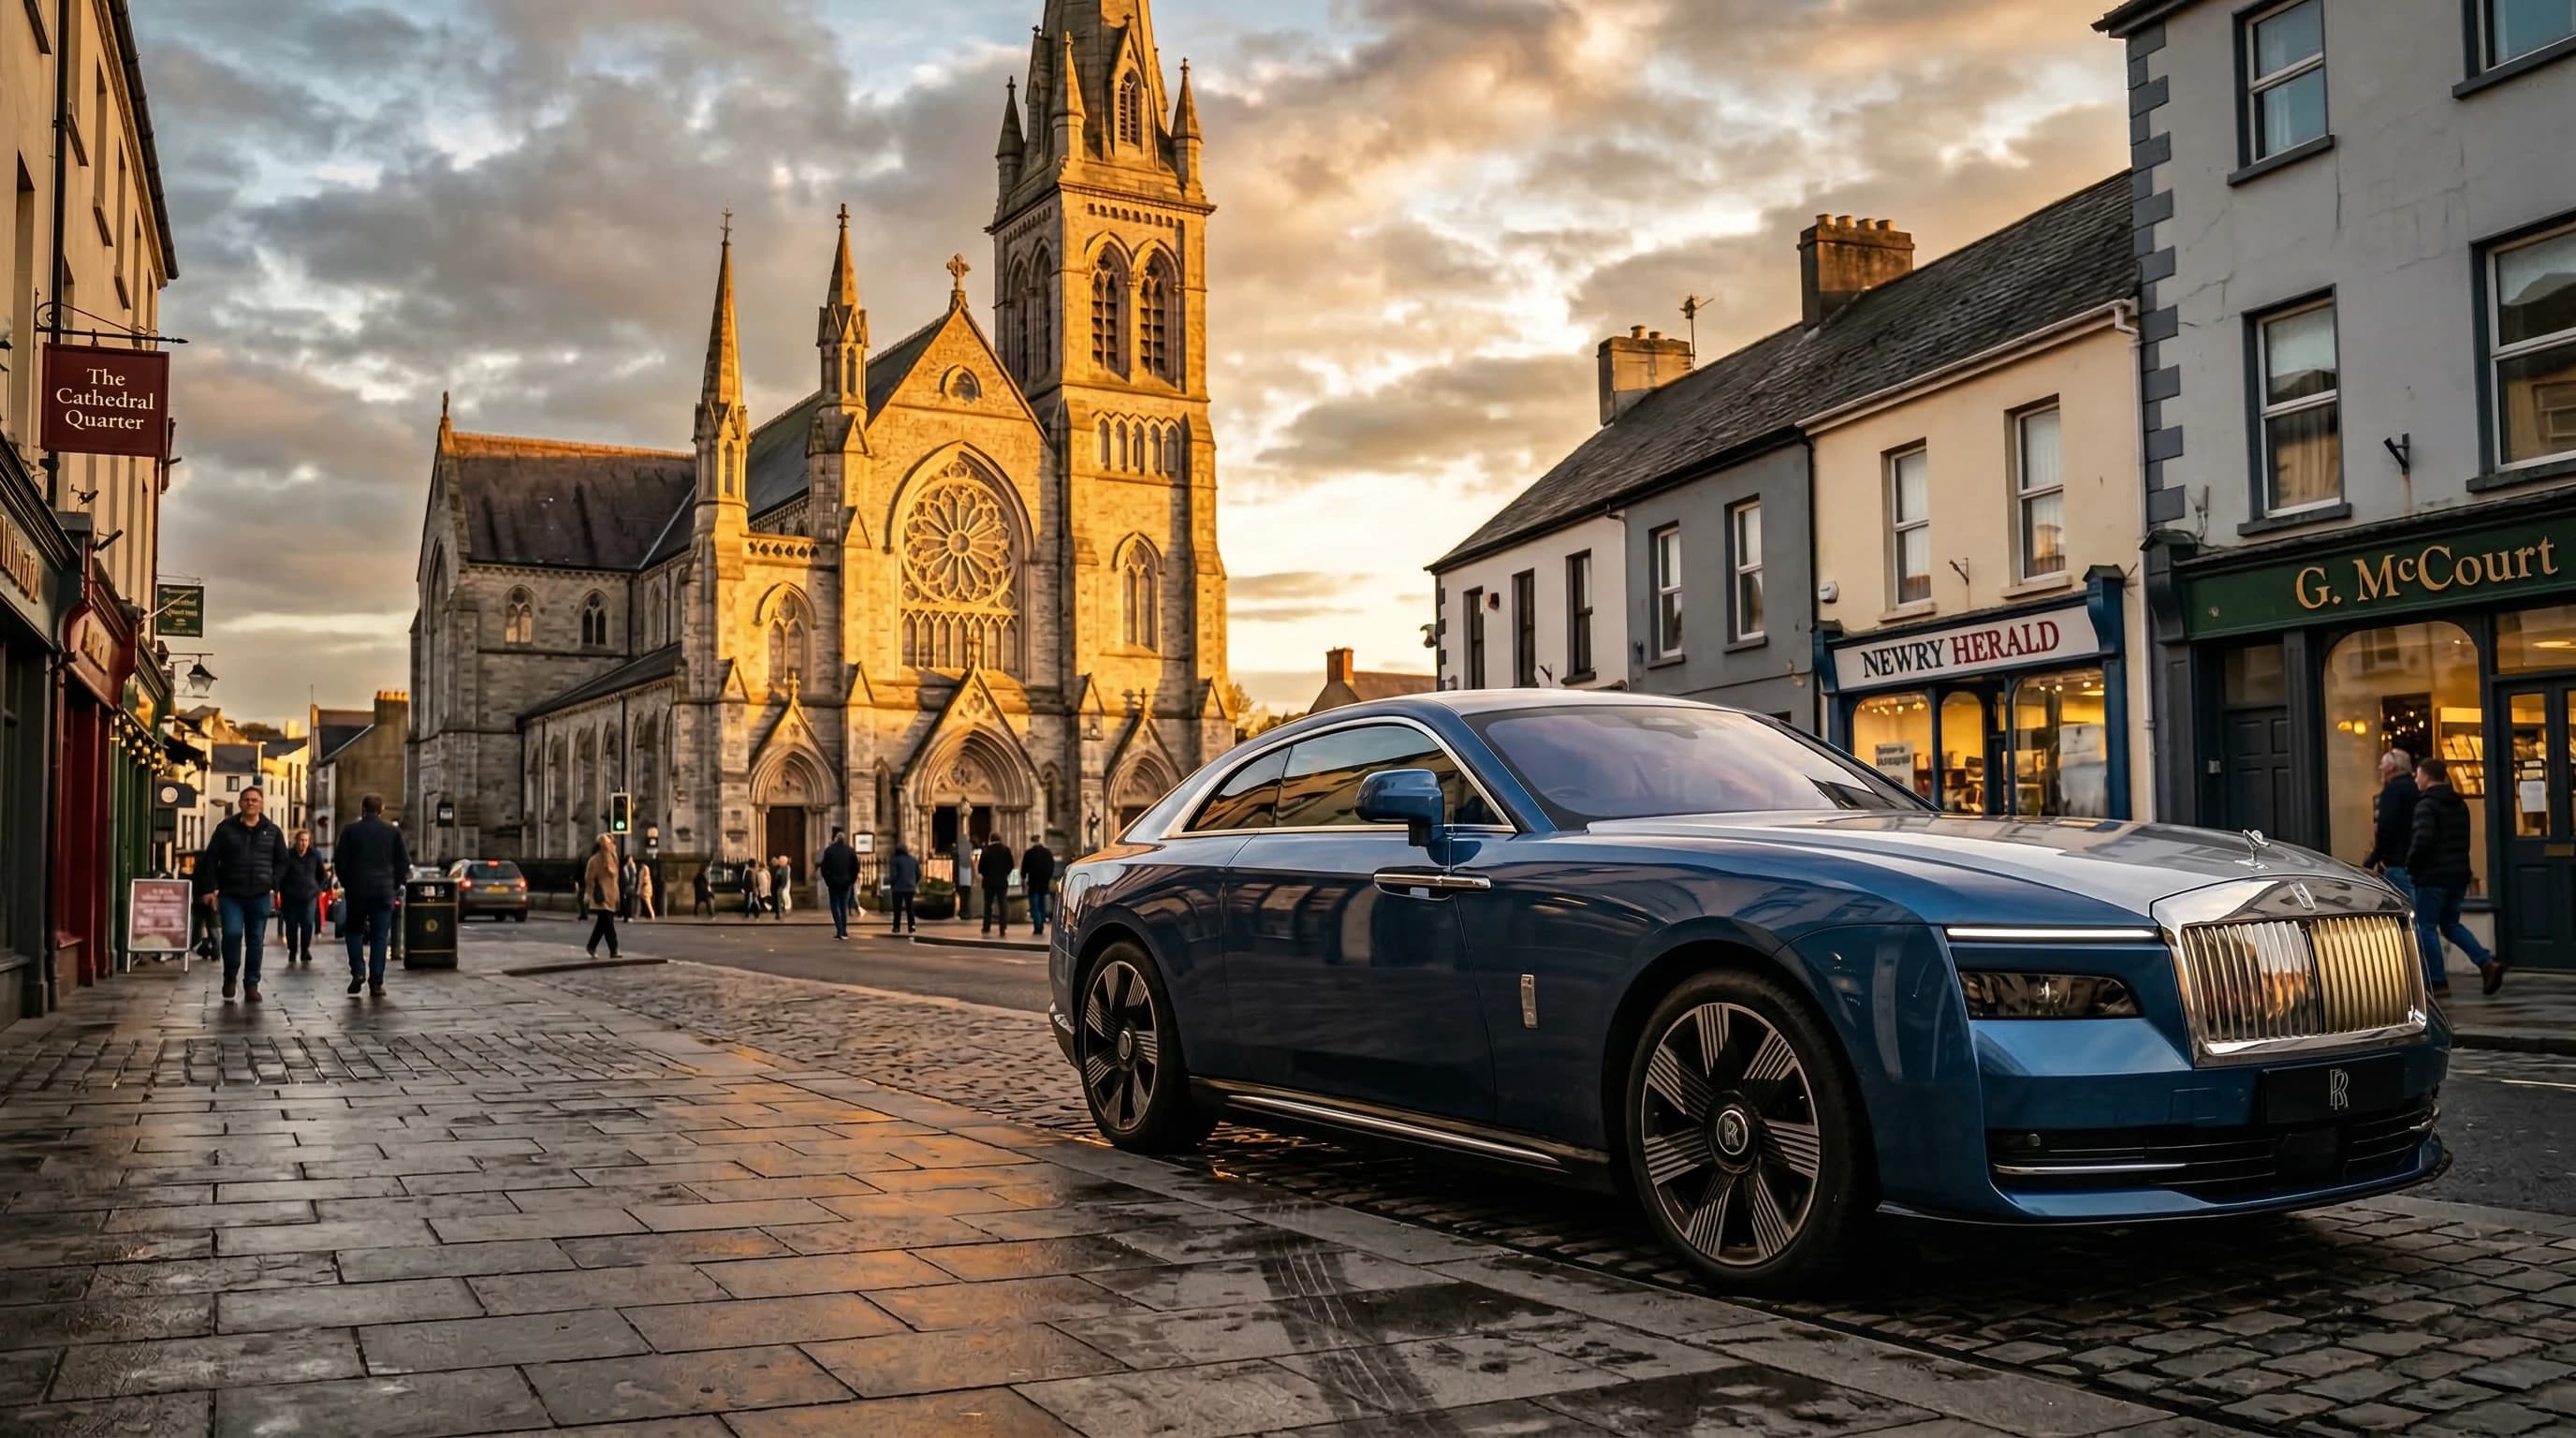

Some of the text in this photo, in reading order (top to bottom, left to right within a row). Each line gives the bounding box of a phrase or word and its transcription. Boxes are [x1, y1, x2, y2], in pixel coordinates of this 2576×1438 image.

[86, 368, 126, 387] The
[55, 388, 155, 410] Cathedral
[65, 409, 145, 431] Quarter
[2295, 536, 2559, 609] G. McCourt
[1860, 621, 2060, 679] NEWRY HERALD
